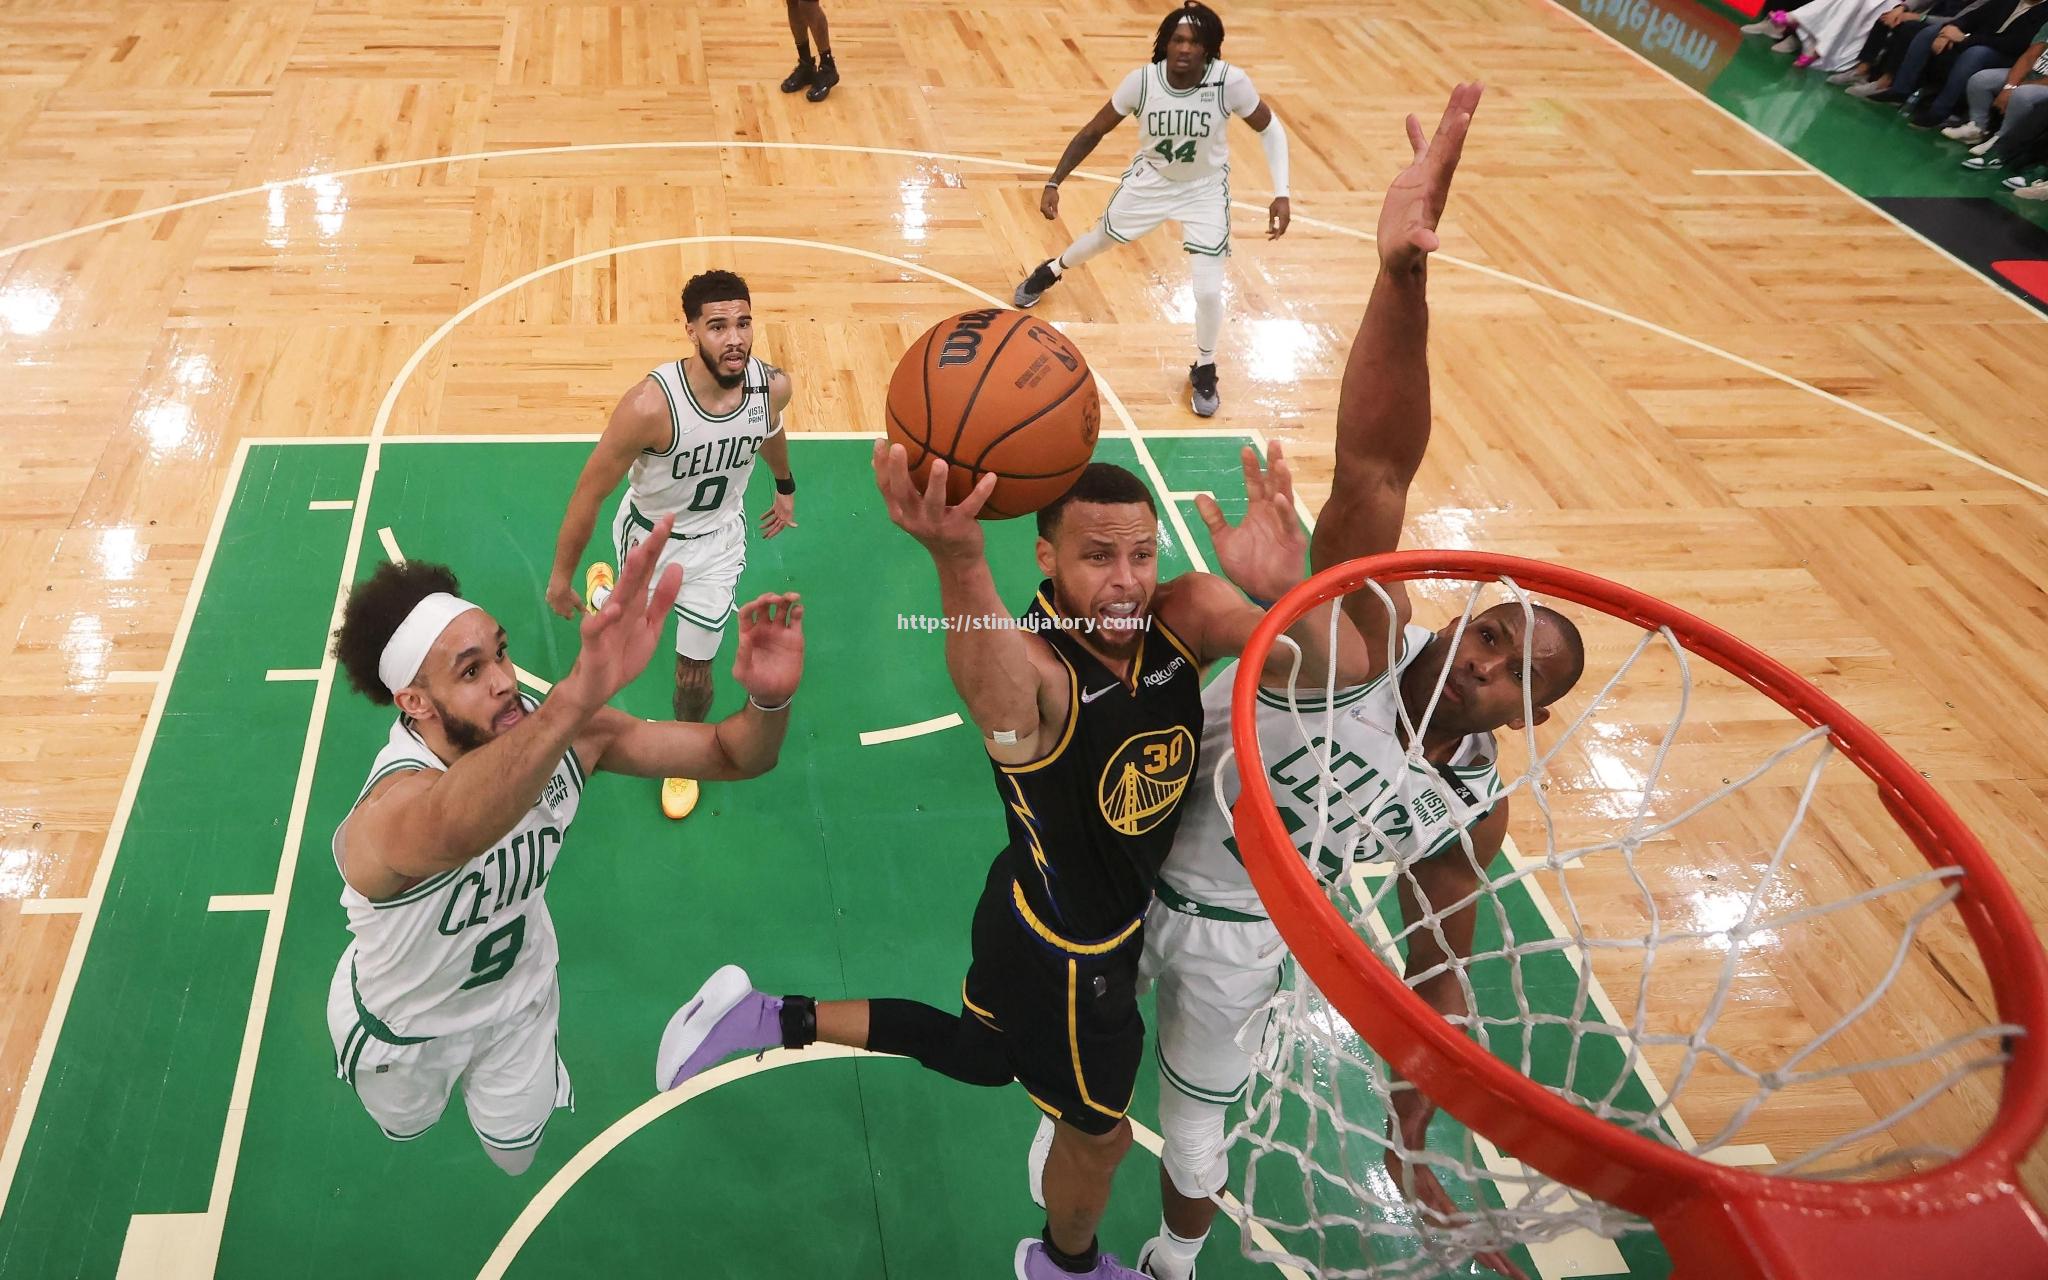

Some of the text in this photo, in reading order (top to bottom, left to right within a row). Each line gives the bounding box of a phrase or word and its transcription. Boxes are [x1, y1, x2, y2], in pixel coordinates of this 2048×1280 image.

[1148, 110, 1211, 137] CELTICS
[1155, 139, 1197, 163] 44
[748, 406, 764, 417] VISTA
[748, 415, 764, 424] PRINT
[687, 476, 728, 511] 0
[1143, 732, 1183, 775] 30
[1420, 788, 1447, 821] VISTA
[1456, 786, 1471, 799] 24
[1412, 797, 1435, 827] PRINT
[438, 826, 570, 936] CELTIC
[459, 914, 526, 990] 9
